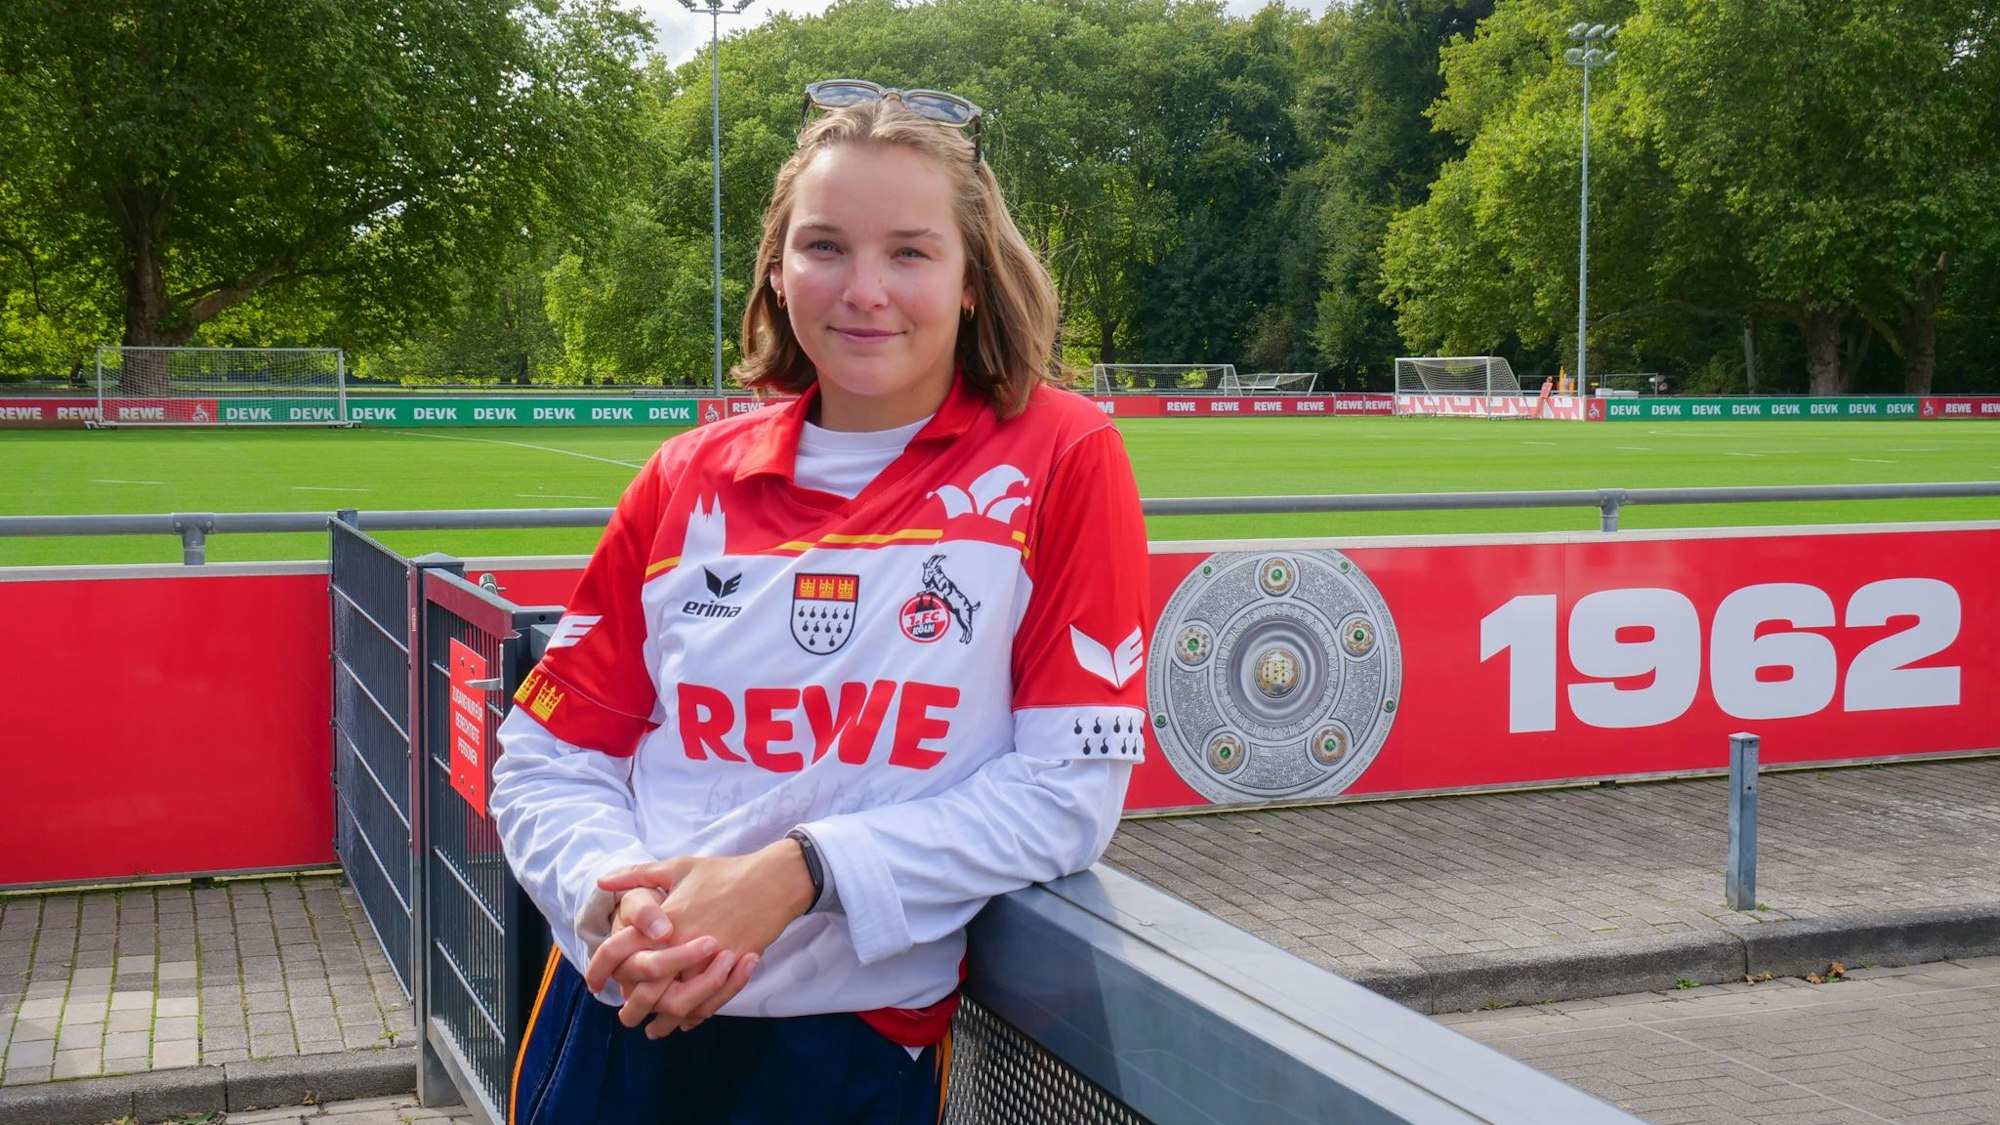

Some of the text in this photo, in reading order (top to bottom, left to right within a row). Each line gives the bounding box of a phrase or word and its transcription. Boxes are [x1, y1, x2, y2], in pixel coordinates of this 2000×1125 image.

[1167, 402, 1324, 411] REWE REWE REWE REWE
[1336, 400, 1392, 410] REWE REWE
[1610, 403, 1914, 415] DEVK DEVK DEVK DEVK DEVK DEVK DEVK DEVK
[1945, 403, 2000, 413] REWE REW
[0, 407, 42, 420] REWE
[119, 407, 165, 420] REWE
[226, 407, 690, 420] DEVK DEVK DEVK DEVK DEVK DEVK DEVK DEVK
[681, 600, 742, 619] erima
[911, 622, 936, 635] KÖLN
[1480, 578, 1962, 733] 1962
[676, 679, 961, 774] REWE
